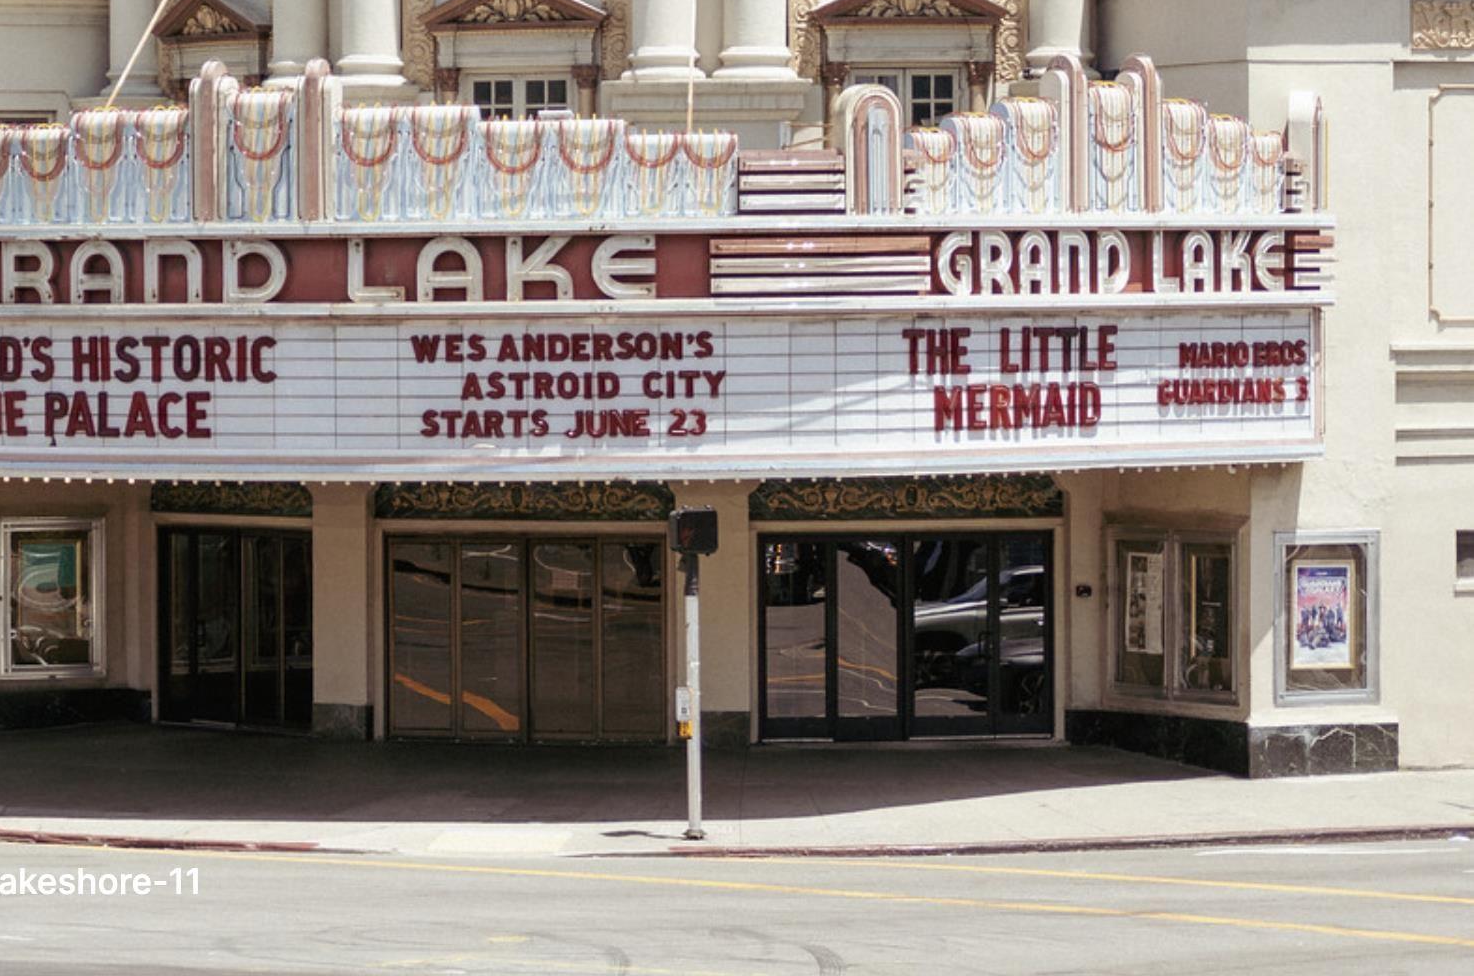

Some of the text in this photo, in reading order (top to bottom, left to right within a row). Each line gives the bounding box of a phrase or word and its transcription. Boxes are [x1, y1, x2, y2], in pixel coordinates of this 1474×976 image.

[347, 234, 657, 302] LAKE
[937, 229, 1287, 296] GRAND LAKE
[72, 334, 278, 384] HISTORIC
[410, 331, 714, 364] WES ANDERSON'S
[902, 325, 1119, 375] THE LITTLE
[1178, 338, 1307, 368] MARIO BROS
[461, 370, 726, 401] ASTROID CITY
[934, 381, 1102, 431] MERMAID
[1157, 376, 1308, 406] GUARDIANS 3
[44, 390, 213, 440] PALACE
[420, 408, 707, 438] STARTS JUNE 23
